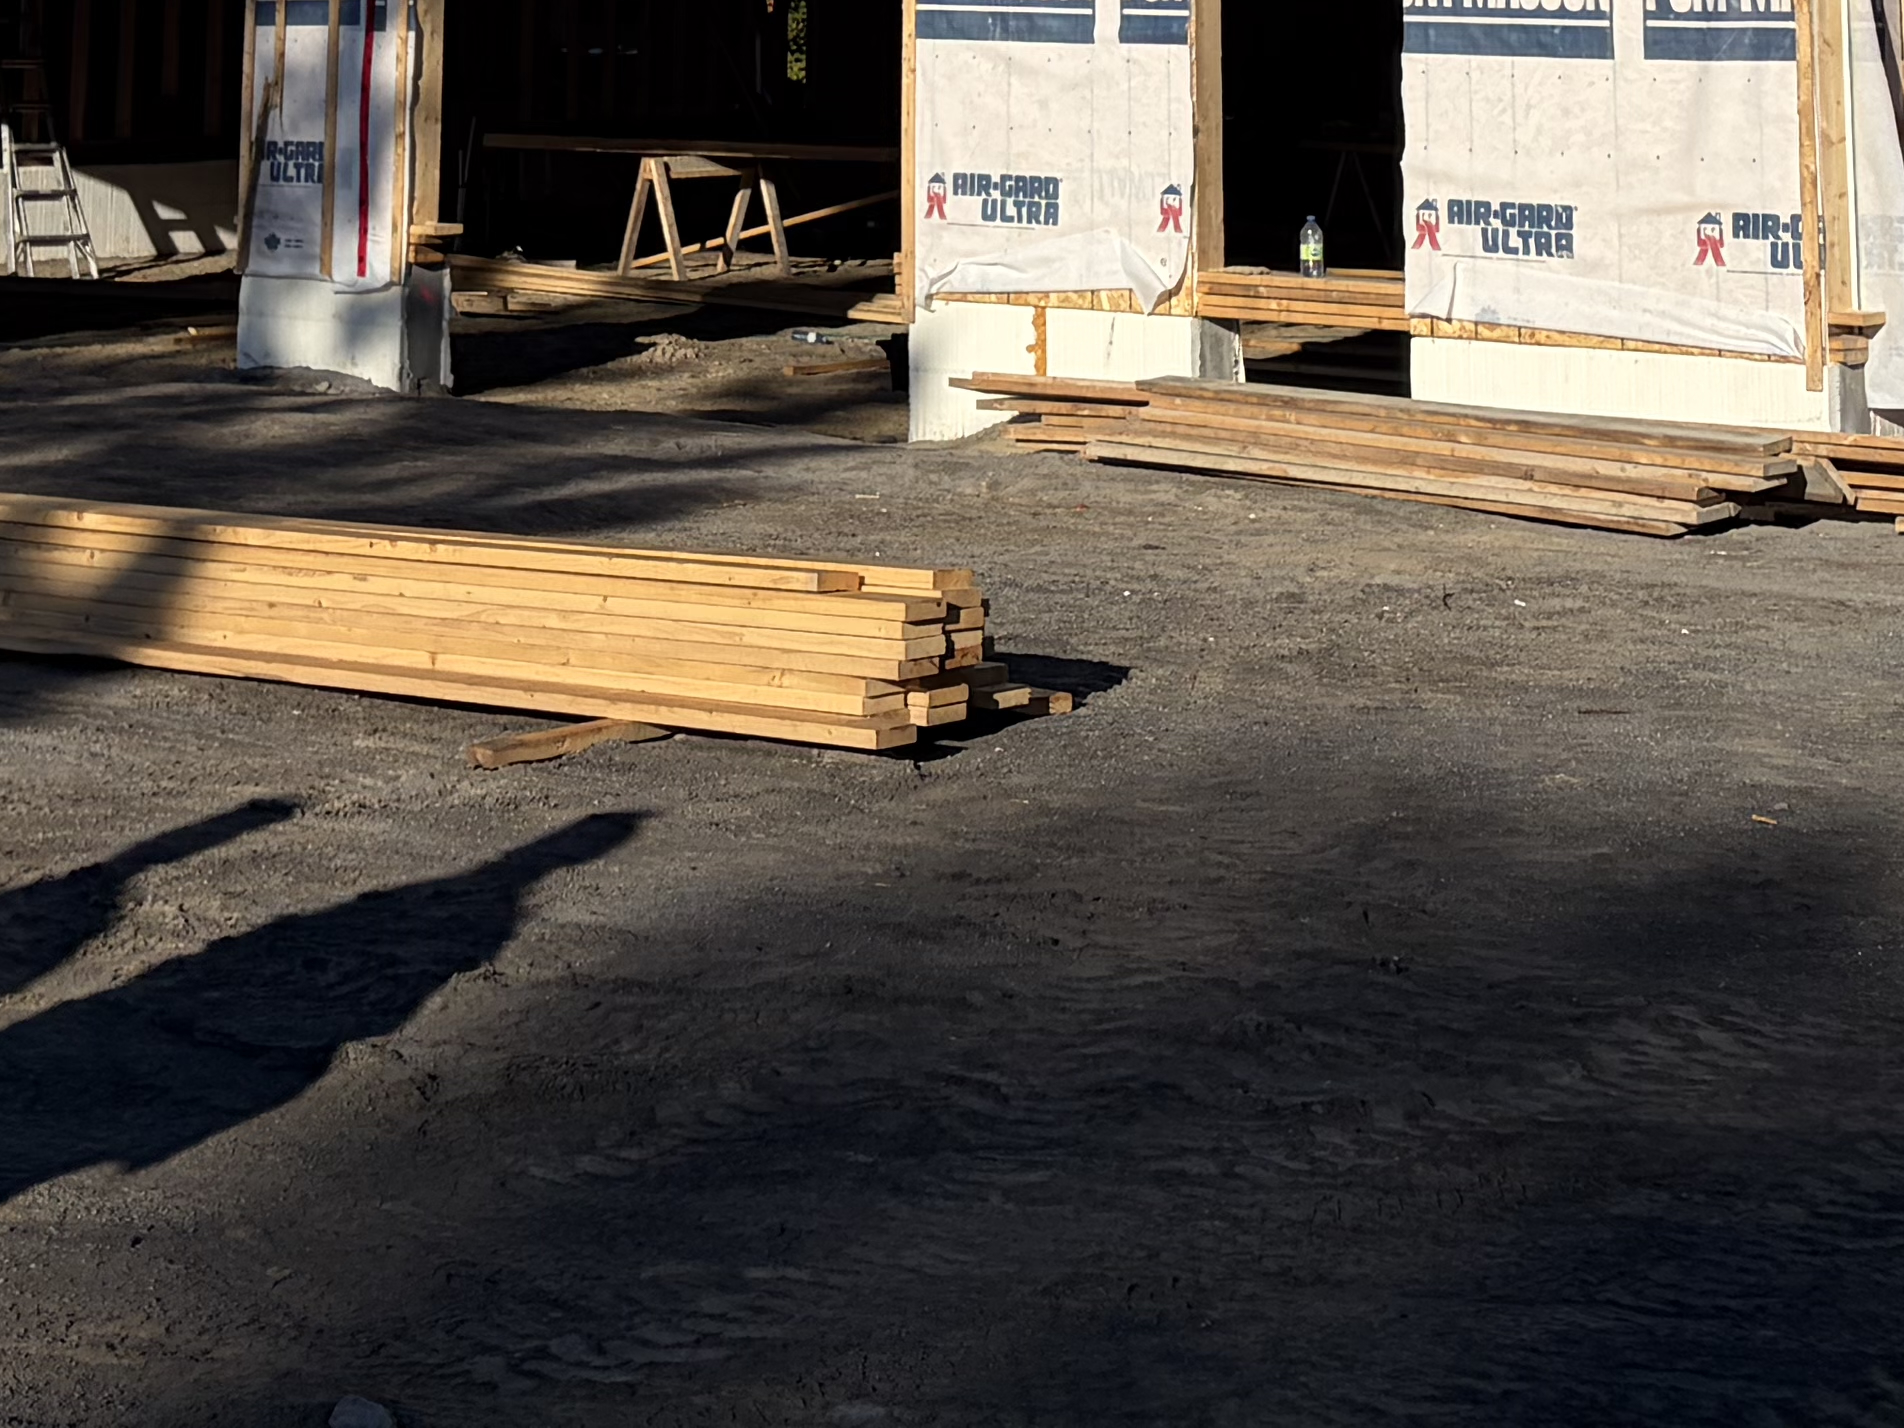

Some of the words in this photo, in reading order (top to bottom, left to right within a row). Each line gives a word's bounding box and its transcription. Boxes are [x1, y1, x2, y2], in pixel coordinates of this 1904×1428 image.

[952, 171, 1060, 201] AIR-GARD
[981, 197, 1060, 227] ULTRA
[1447, 199, 1575, 230] AIR-GARD
[1481, 225, 1575, 259] ULTRA
